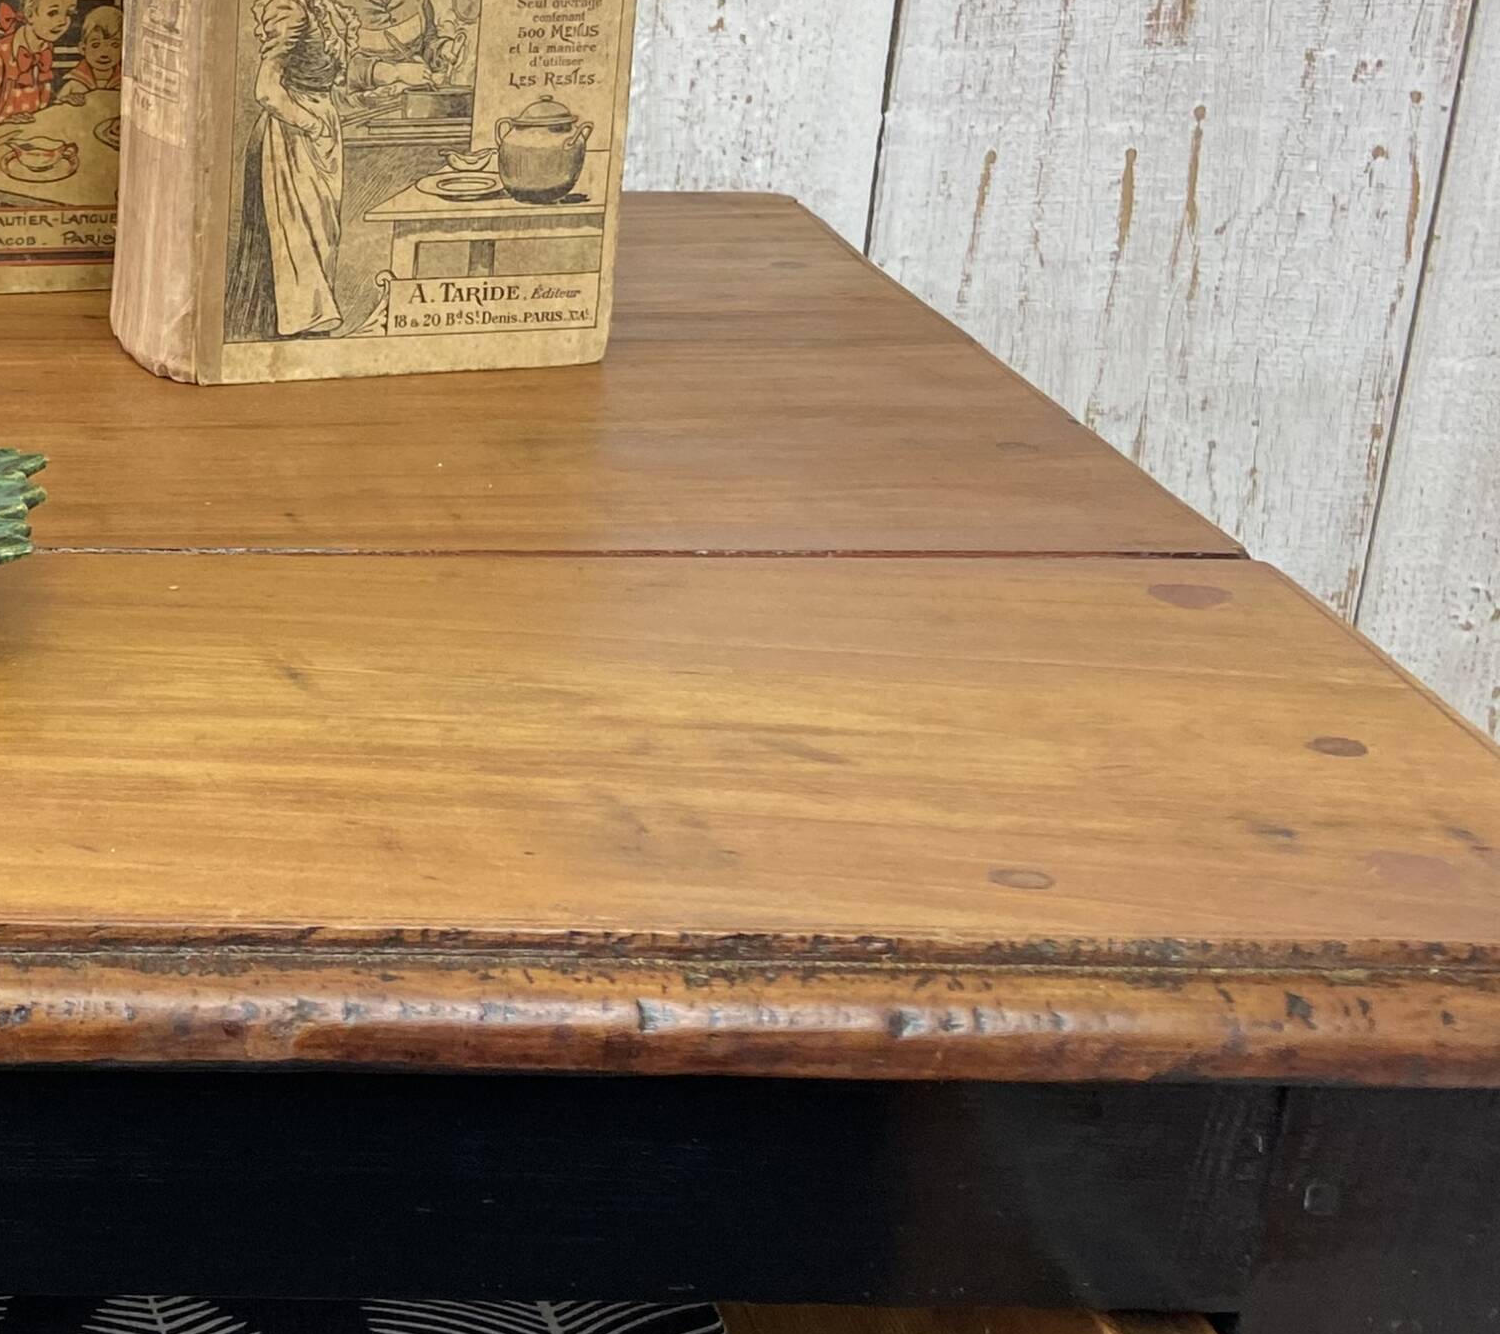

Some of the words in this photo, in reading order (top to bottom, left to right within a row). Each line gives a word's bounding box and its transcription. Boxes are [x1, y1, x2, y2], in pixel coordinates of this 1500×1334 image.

[532, 11, 586, 23] contenant
[517, 26, 546, 39] 500
[550, 22, 600, 45] MENUS
[508, 43, 521, 55] et
[528, 41, 540, 54] la
[508, 71, 537, 90] LES
[408, 283, 435, 305] A.
[530, 283, 582, 301] Éditeur
[393, 314, 408, 329] 18
[423, 312, 441, 328] 20
